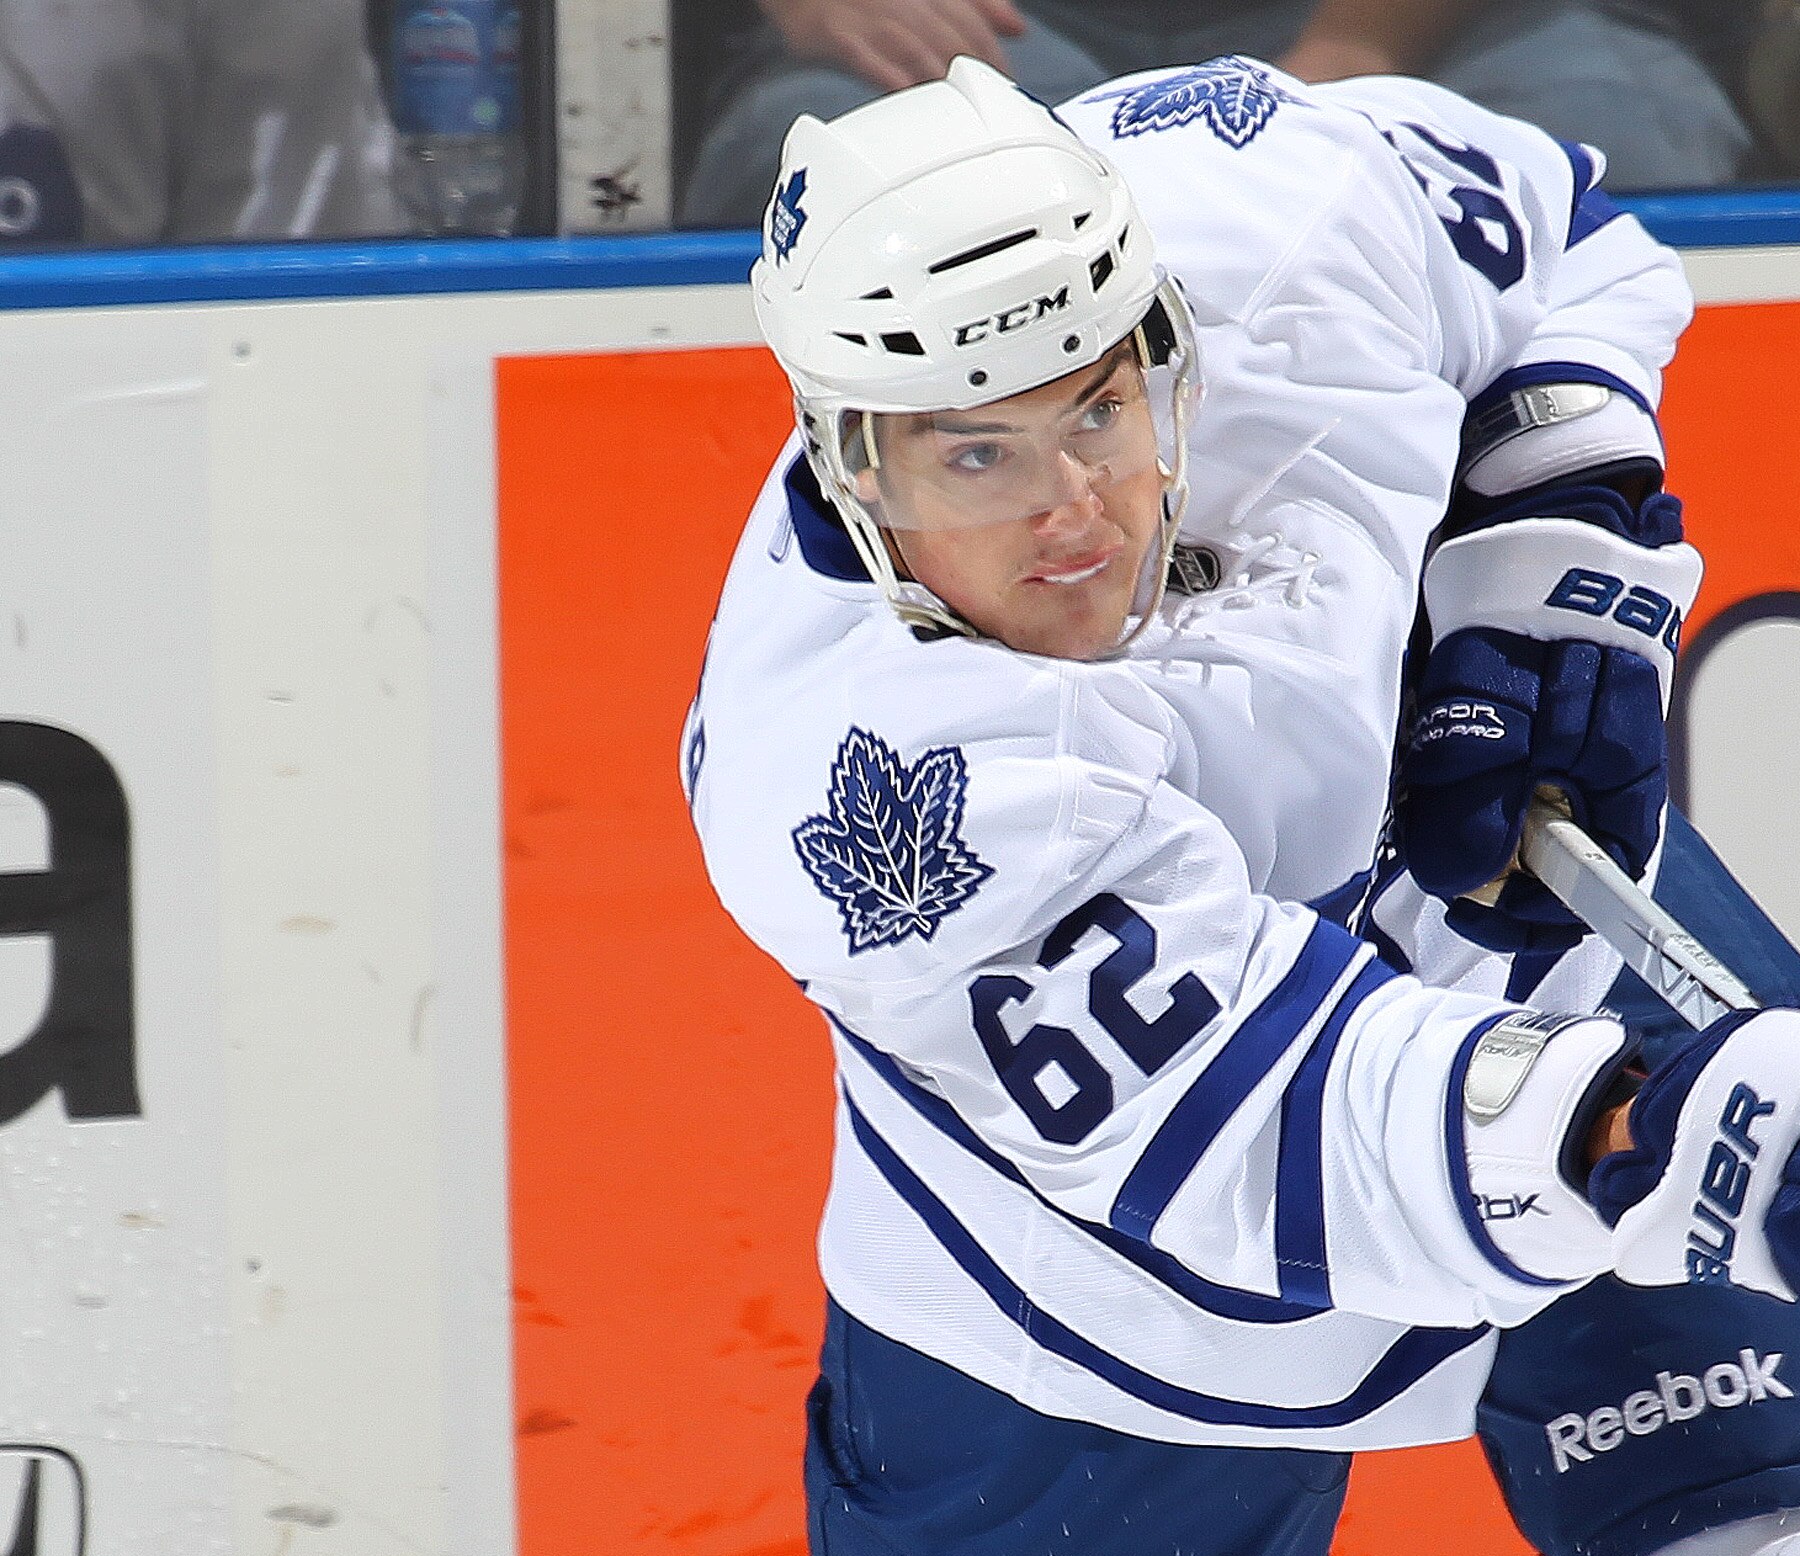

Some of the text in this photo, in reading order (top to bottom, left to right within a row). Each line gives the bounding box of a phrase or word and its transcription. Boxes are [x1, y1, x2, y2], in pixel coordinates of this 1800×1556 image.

[952, 286, 1070, 347] CCM
[969, 892, 1224, 1146] 62
[1545, 1348, 1795, 1474] Reebok
